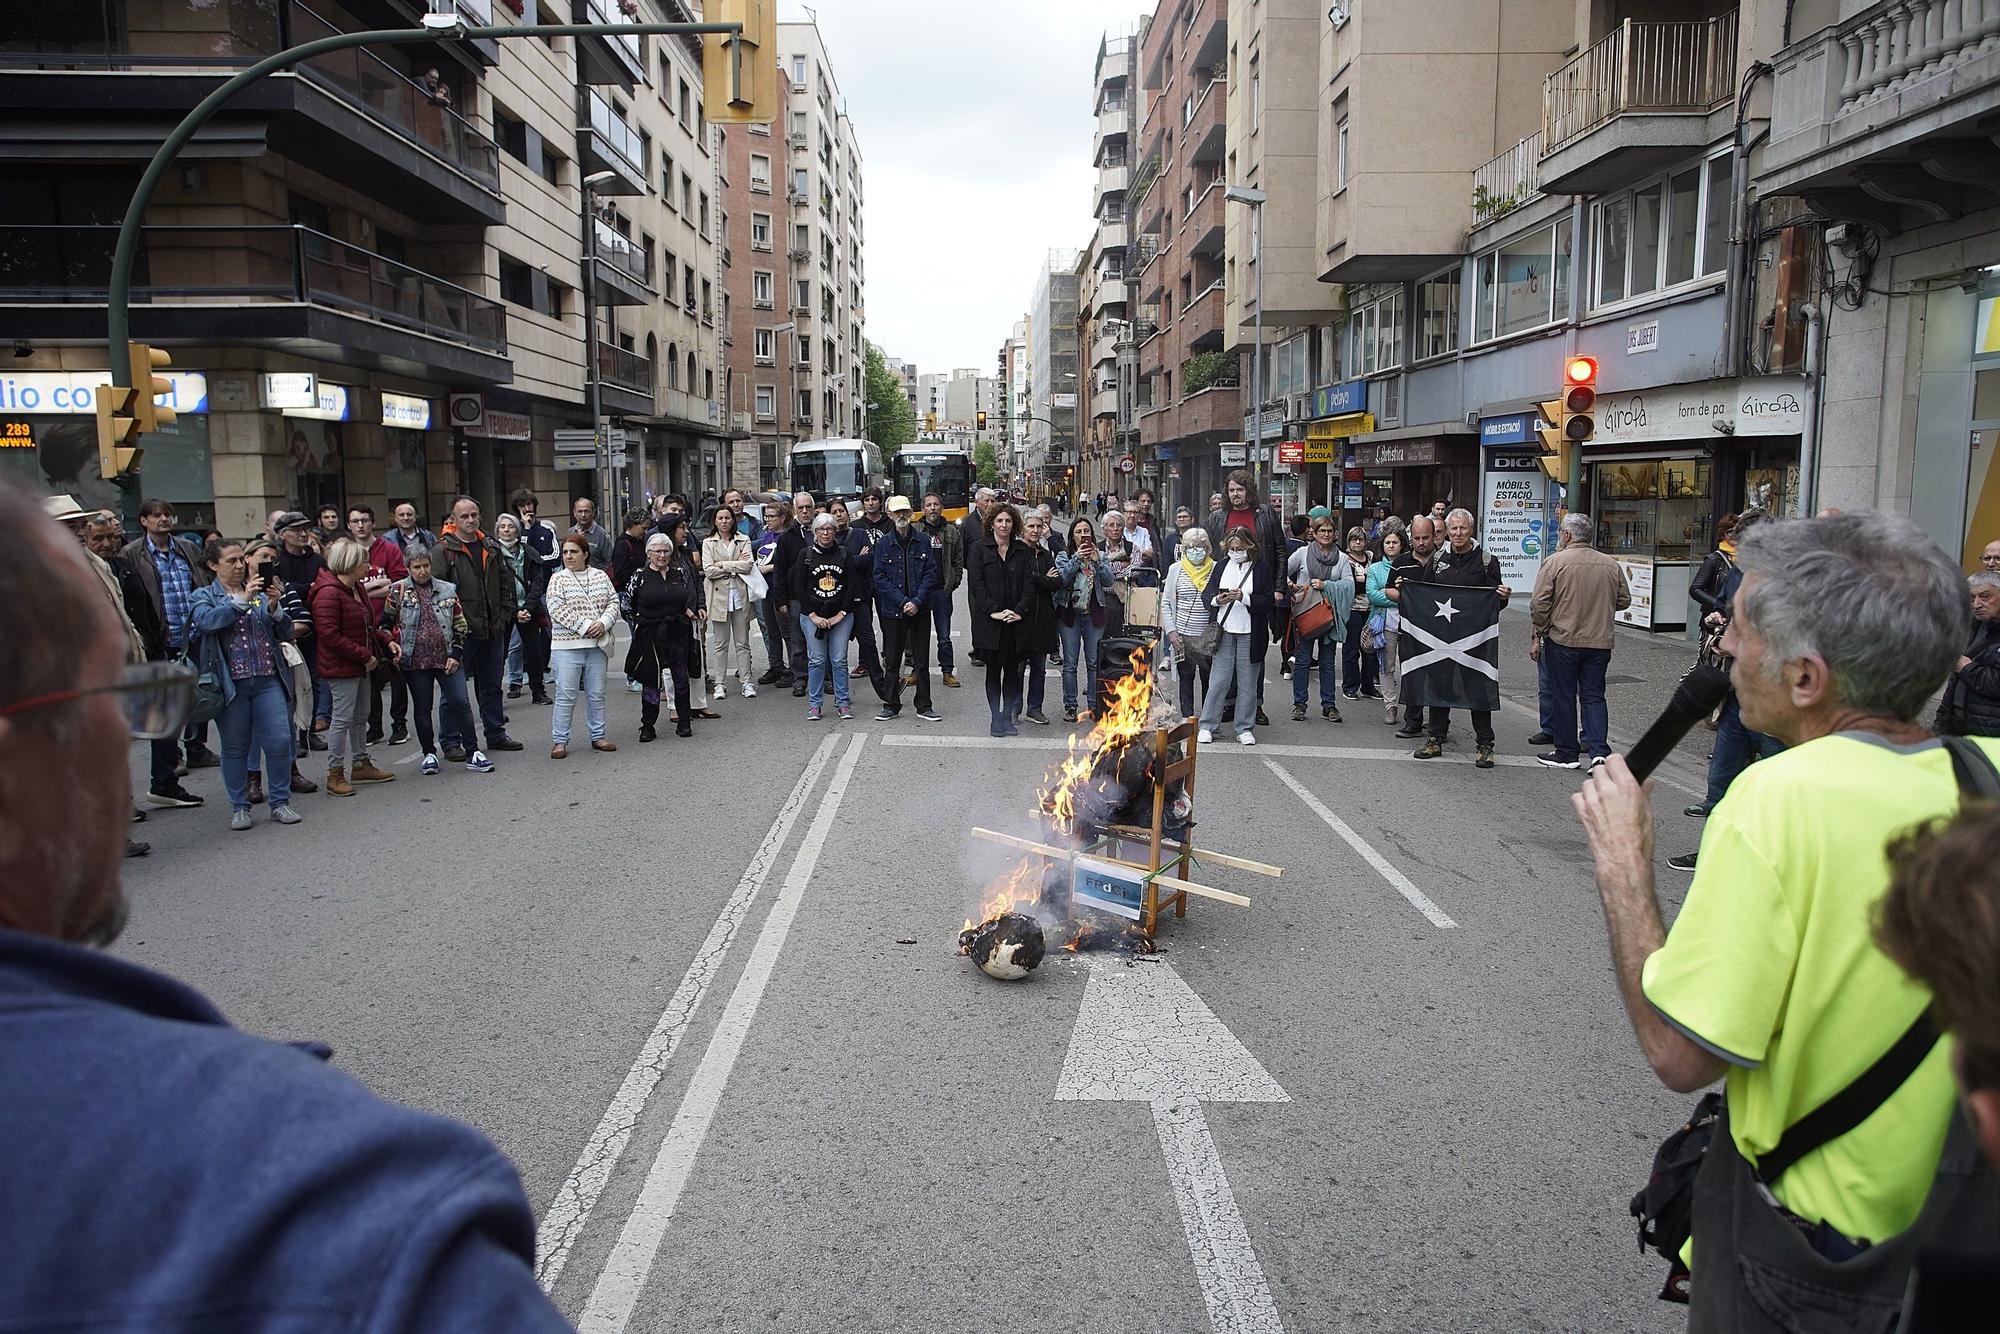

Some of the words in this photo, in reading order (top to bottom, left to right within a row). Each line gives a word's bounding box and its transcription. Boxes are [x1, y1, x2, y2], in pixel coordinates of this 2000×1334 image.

[1330, 388, 1350, 412] pelayo
[398, 405, 422, 421] control
[1679, 402, 1695, 418] forn
[1698, 400, 1710, 416] de
[1712, 404, 1725, 419] pa
[6, 423, 30, 437] 289
[1484, 423, 1502, 436] MÒBILS
[1501, 419, 1521, 434] ESTACIÓ
[906, 455, 915, 464] L2
[1496, 479, 1531, 490] MÒBILS
[1496, 489, 1533, 500] ESTACIÓ
[1490, 509, 1523, 517] Reparació
